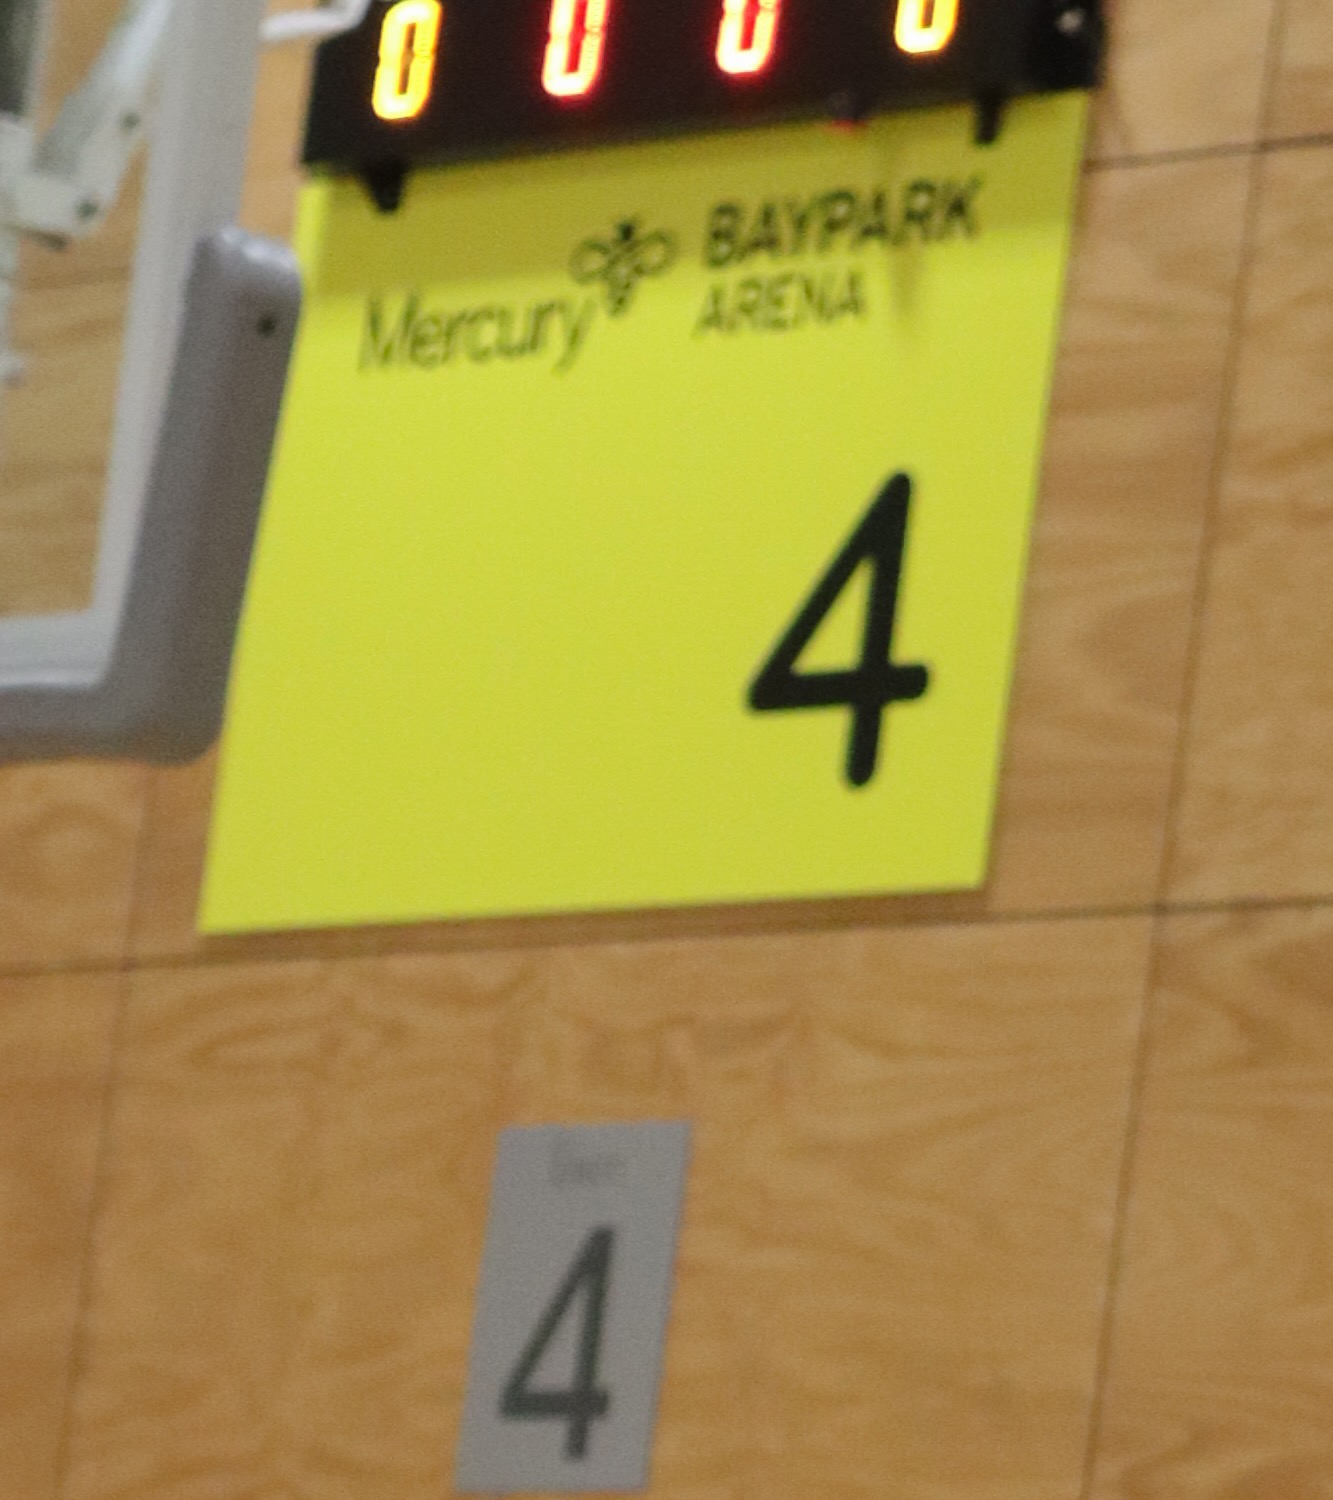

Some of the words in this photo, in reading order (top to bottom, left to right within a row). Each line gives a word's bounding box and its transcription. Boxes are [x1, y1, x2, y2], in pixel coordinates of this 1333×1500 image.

[372, 0, 441, 119] 0
[705, 178, 986, 268] BAYPARK
[359, 290, 597, 374] Mercury
[694, 270, 867, 337] ARENA
[747, 469, 931, 791] 4
[497, 1223, 618, 1462] 4
